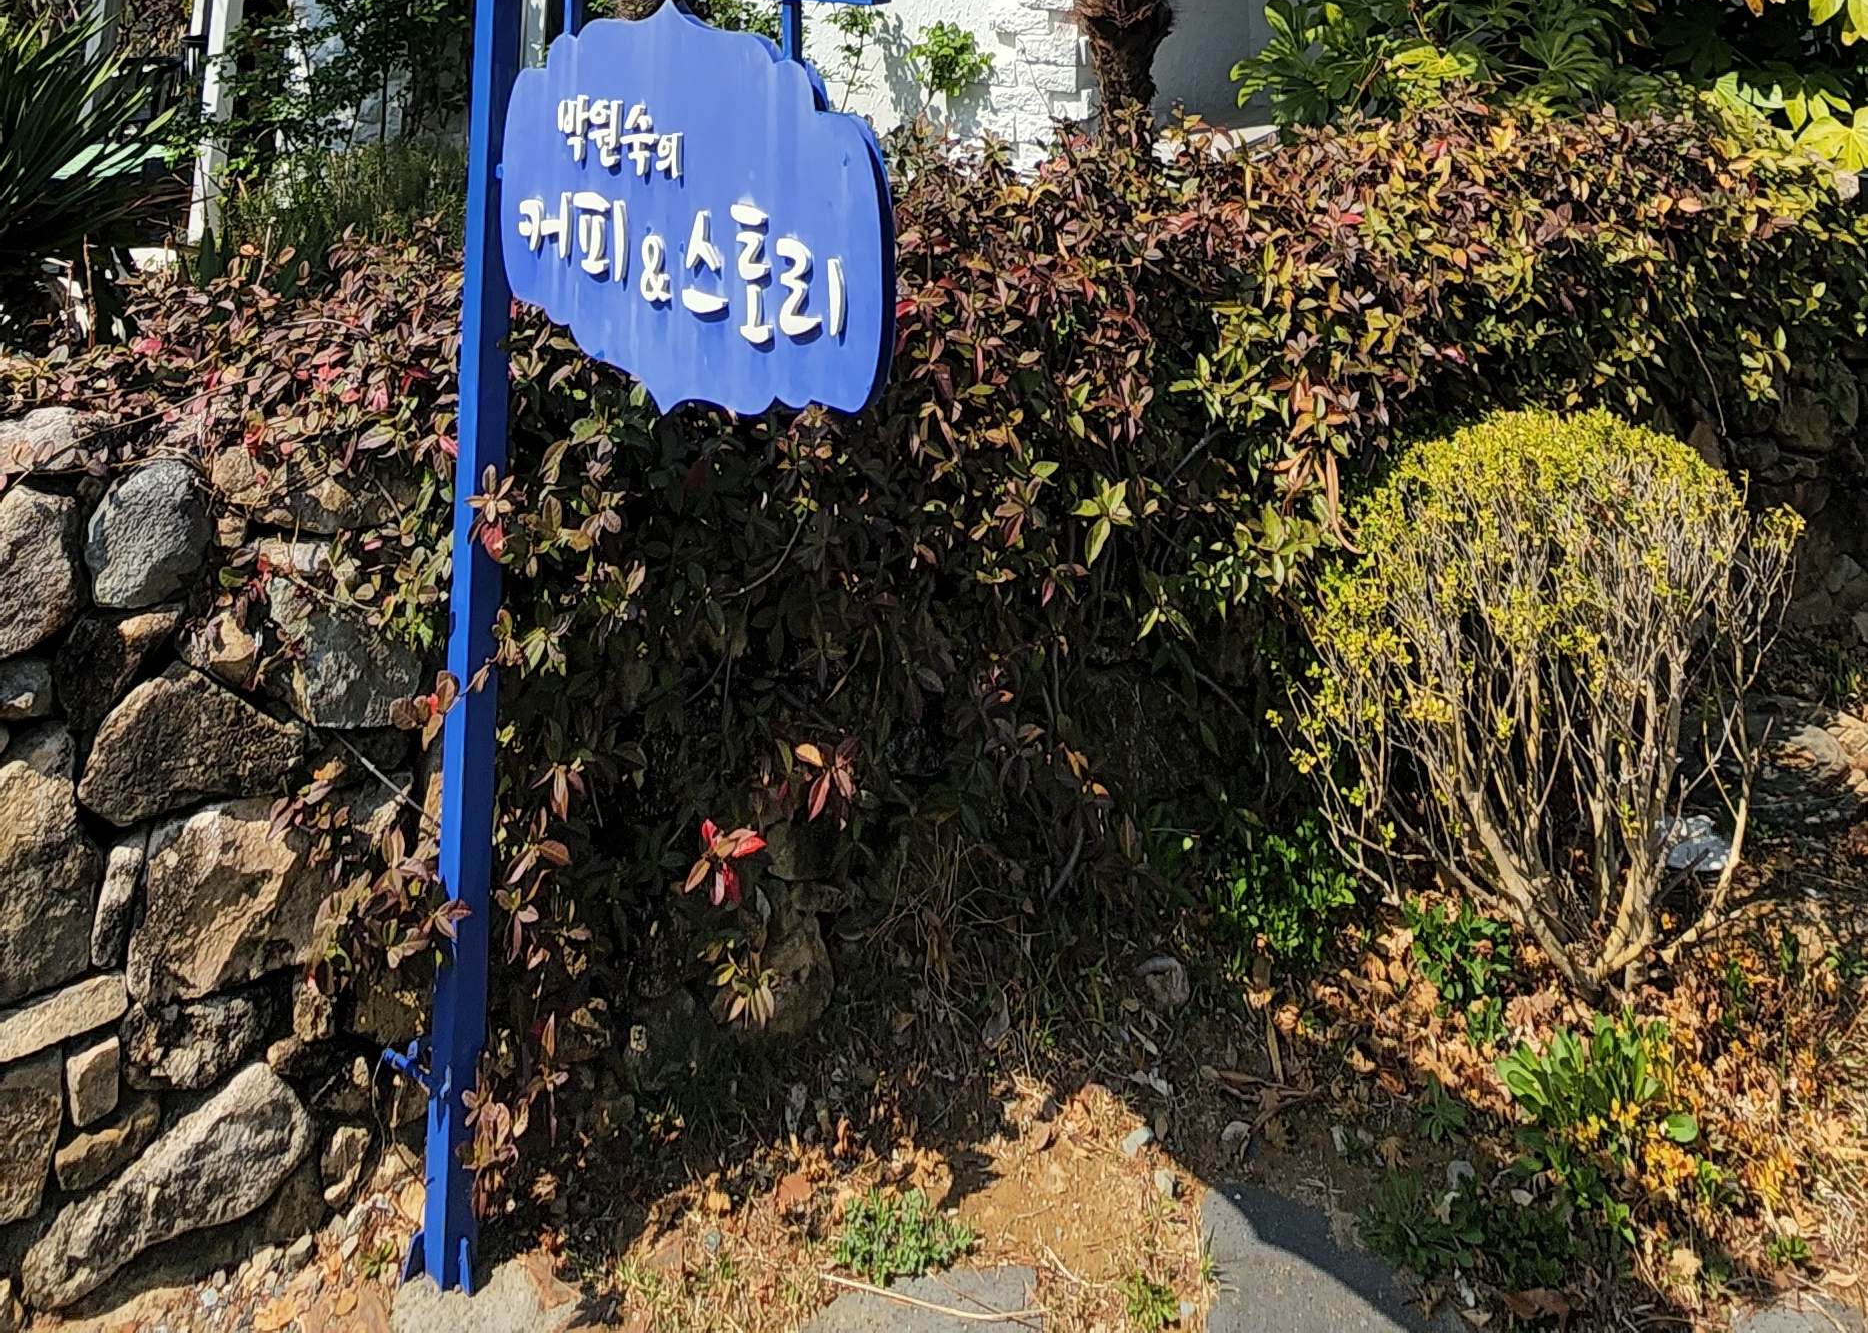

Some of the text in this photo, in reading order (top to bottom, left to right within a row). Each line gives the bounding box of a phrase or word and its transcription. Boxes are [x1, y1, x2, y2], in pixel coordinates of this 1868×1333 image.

[518, 190, 847, 344] 커피 & 스토리
